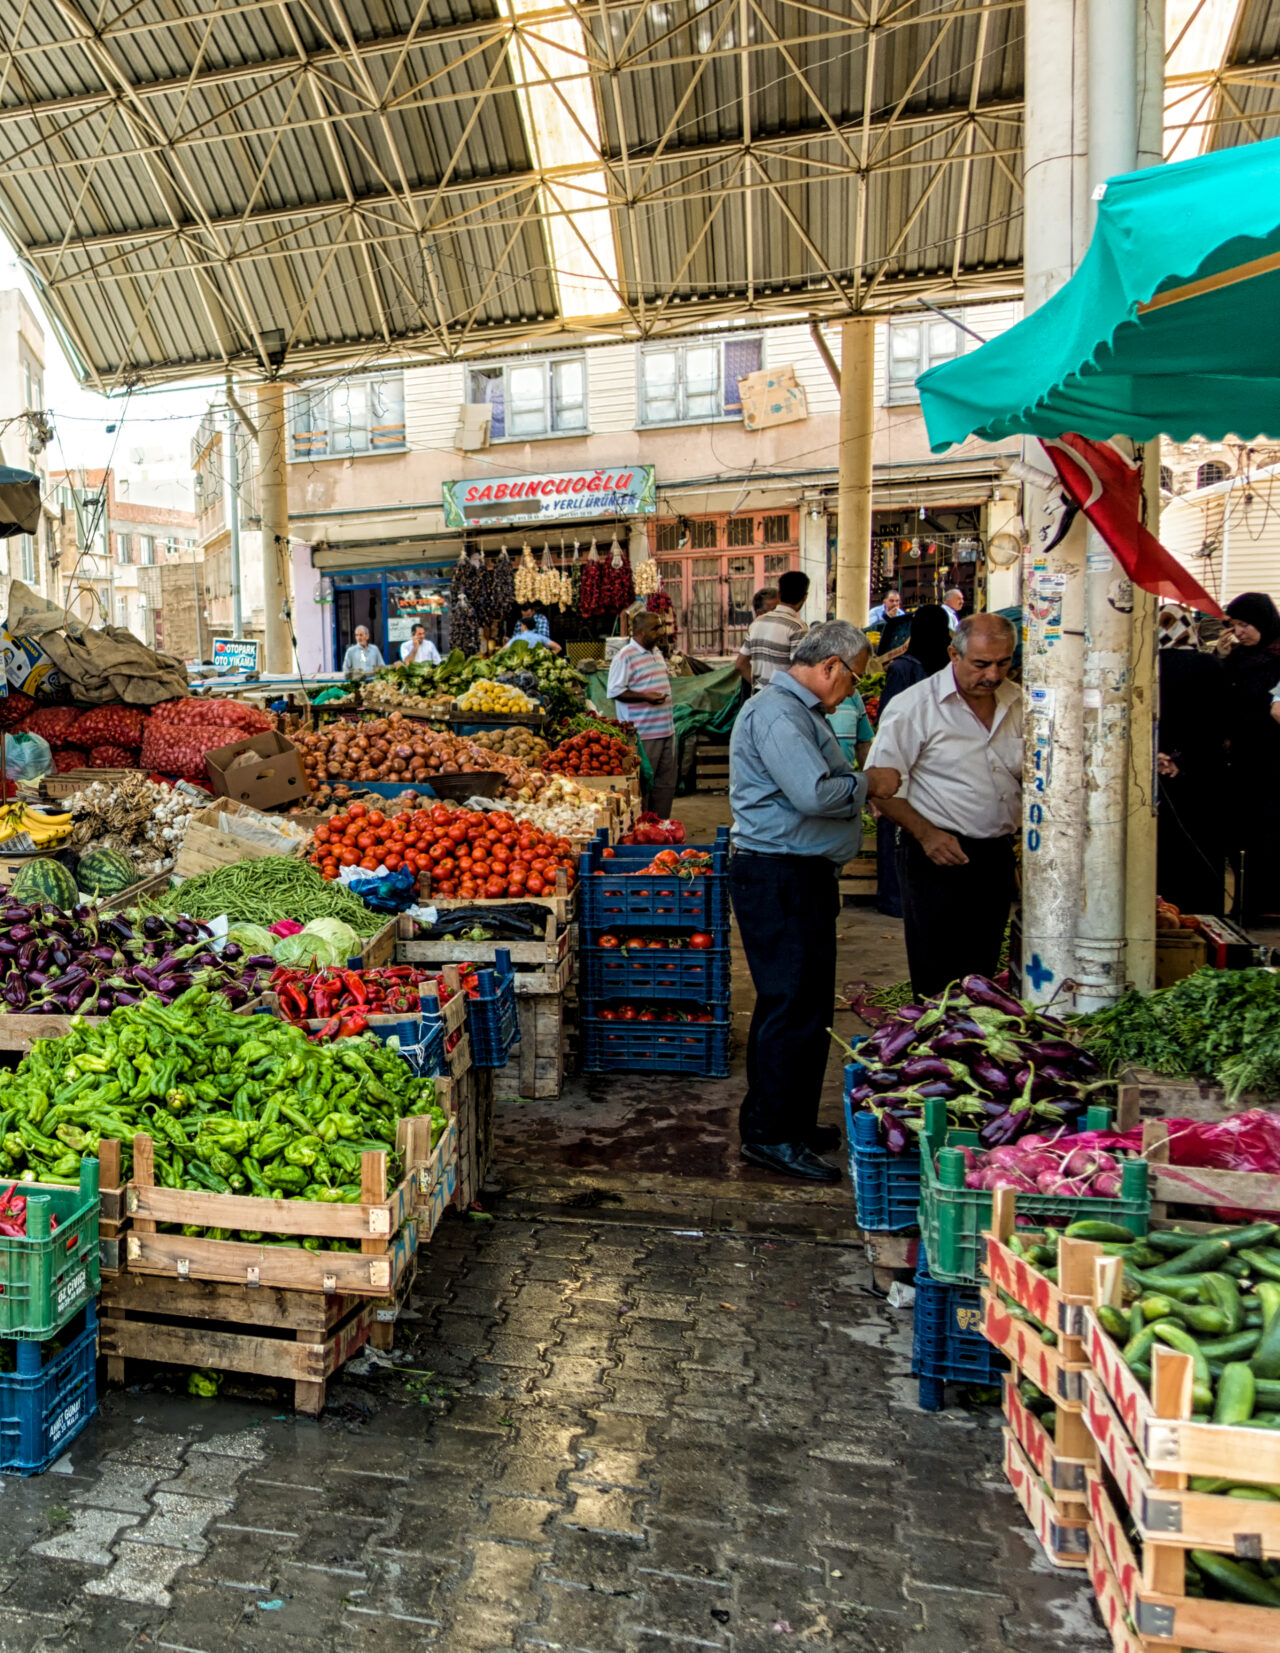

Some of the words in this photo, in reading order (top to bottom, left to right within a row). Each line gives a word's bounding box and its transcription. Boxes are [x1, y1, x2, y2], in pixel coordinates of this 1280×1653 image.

[465, 470, 634, 502] SABUNCUOĞLU
[226, 644, 256, 655] OTOPARK
[215, 656, 228, 665] OTO
[230, 656, 254, 667] YIKAMA
